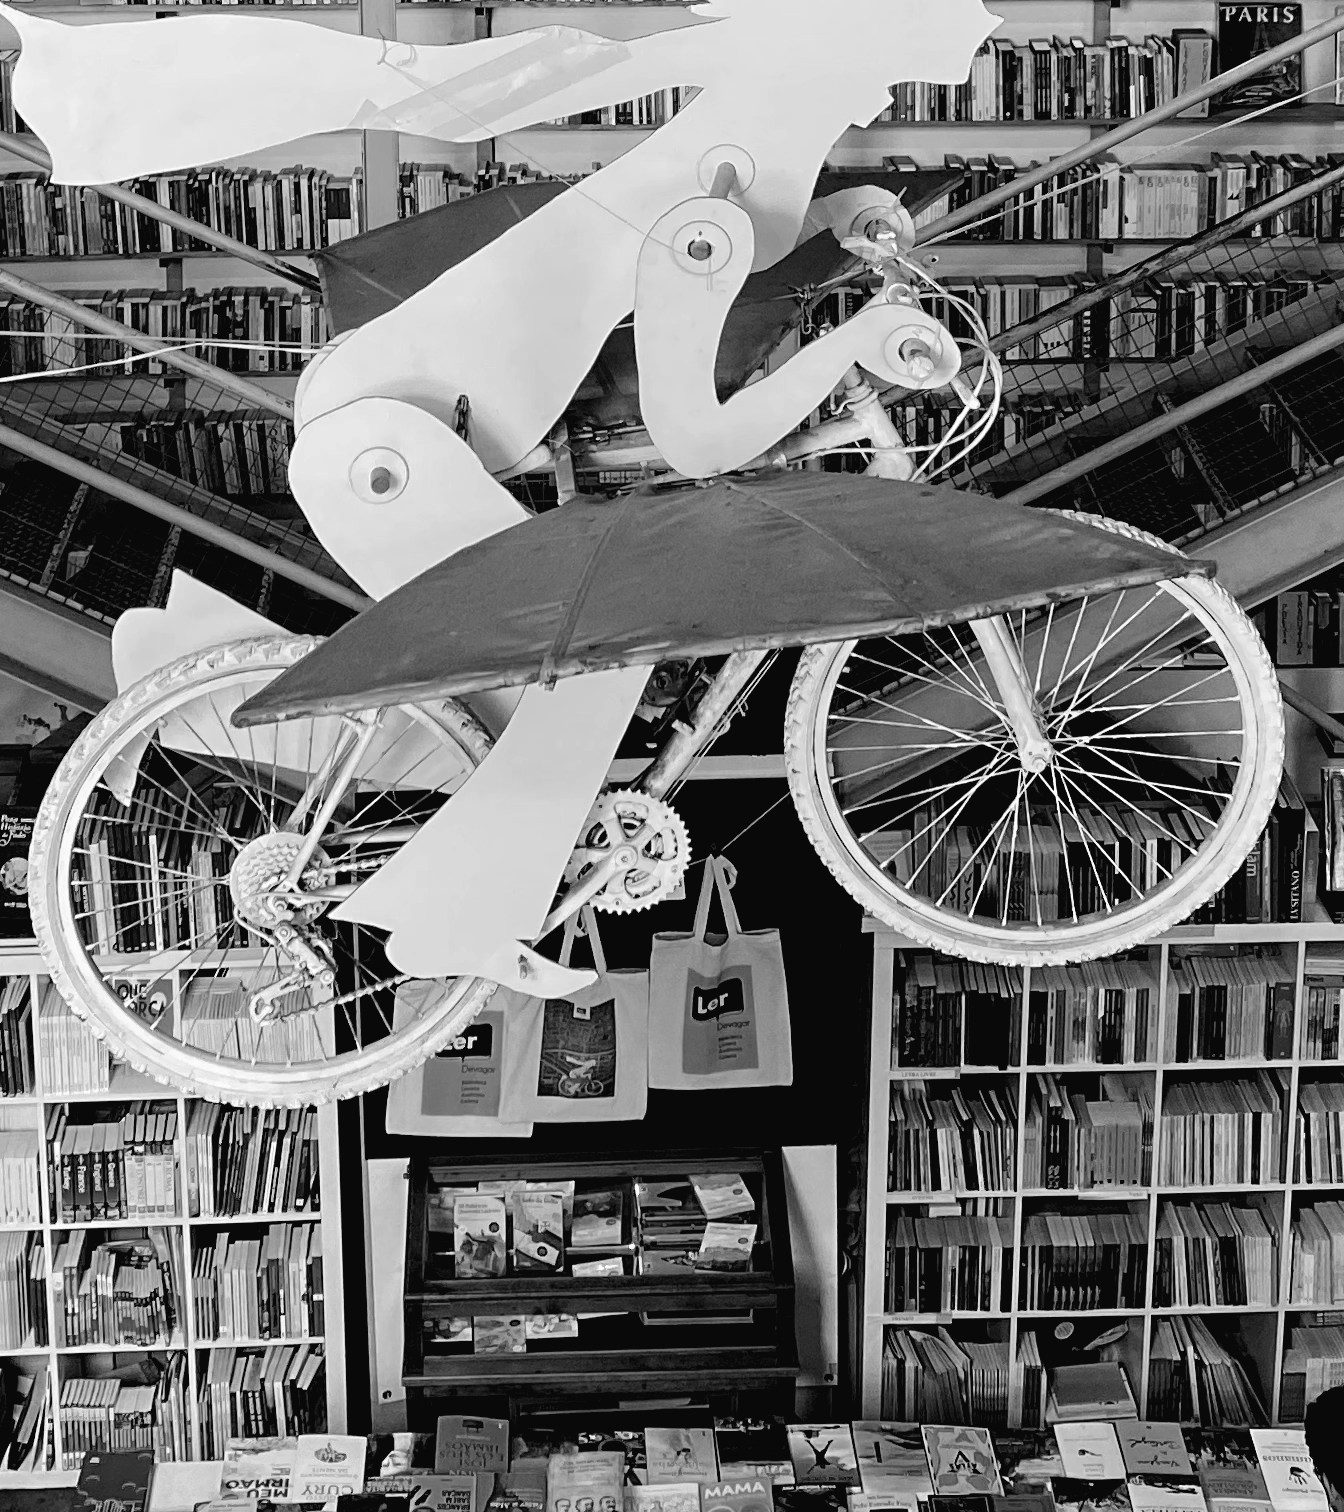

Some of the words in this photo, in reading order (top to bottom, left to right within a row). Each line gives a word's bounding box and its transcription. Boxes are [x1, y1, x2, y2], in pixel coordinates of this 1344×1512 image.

[1222, 6, 1296, 24] PARIS
[117, 983, 147, 1001] QUE
[697, 990, 729, 1015] Ler
[716, 1019, 752, 1033] Devagar
[461, 1064, 496, 1076] Devagar
[77, 1164, 87, 1194] France
[93, 1162, 103, 1192] England
[107, 1161, 116, 1188] Greece
[246, 1489, 289, 1499] MEU
[301, 1484, 354, 1496] CURY
[704, 1481, 766, 1500] MAMA
